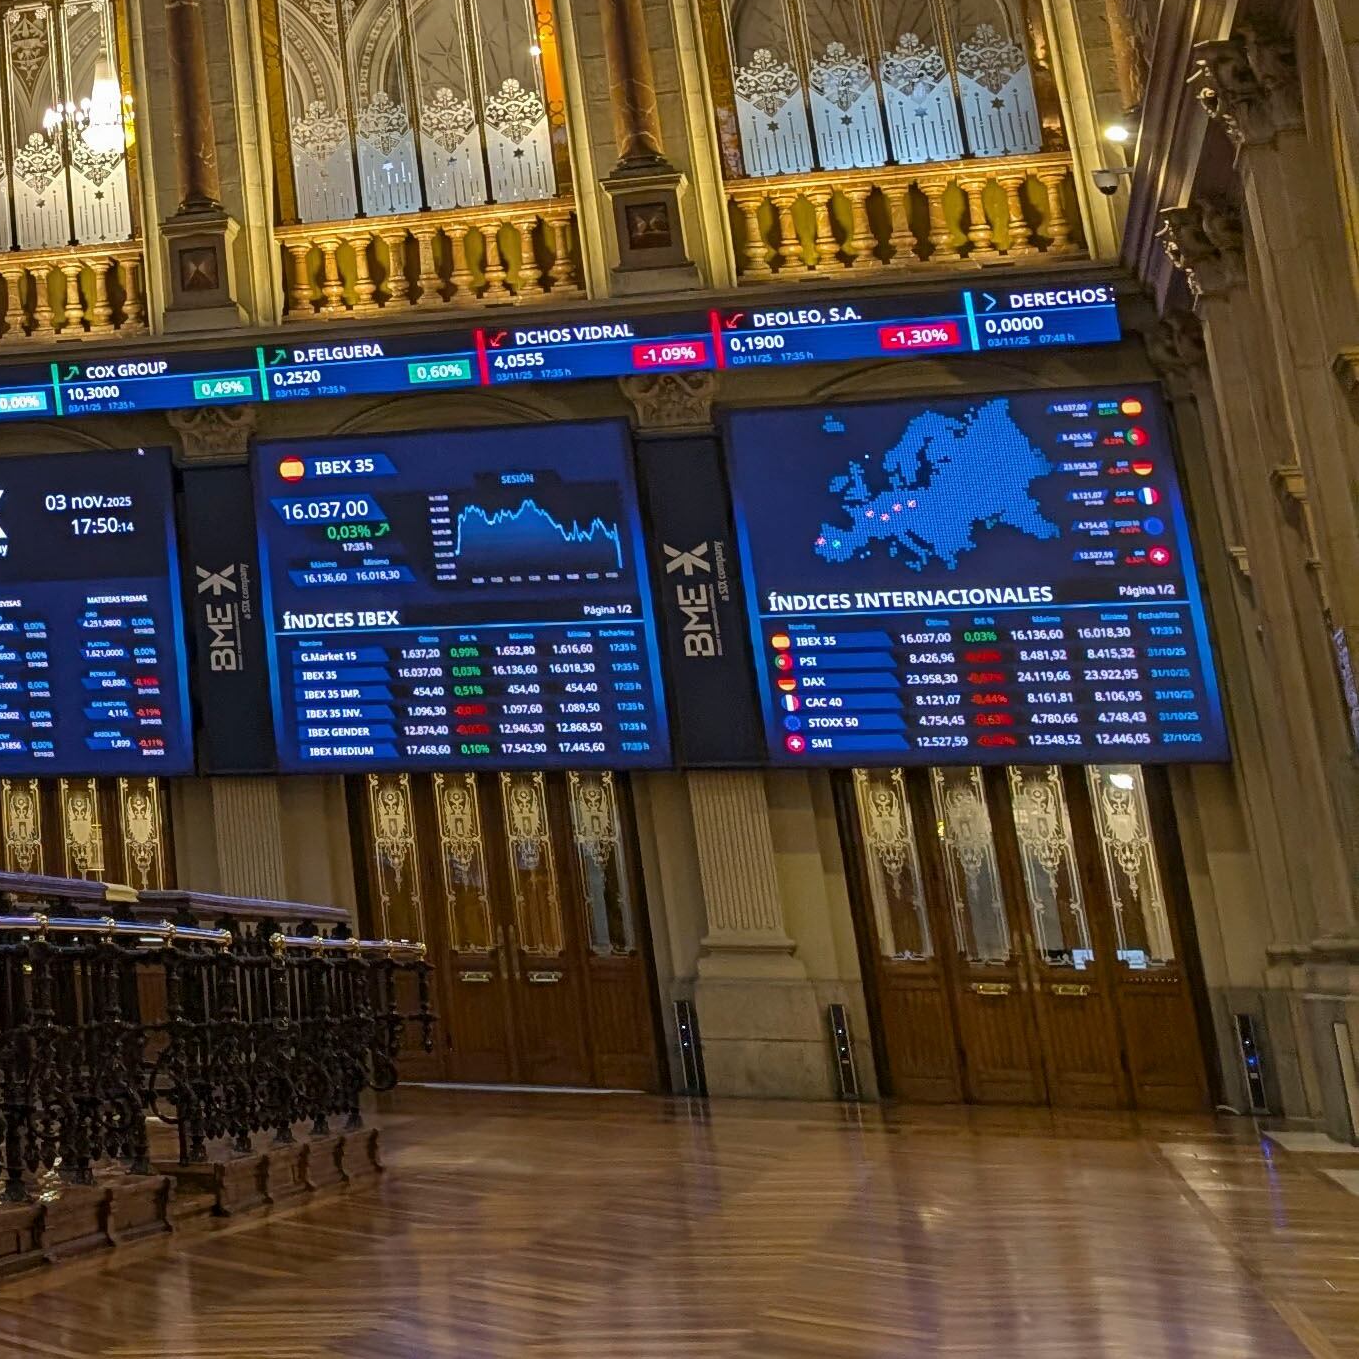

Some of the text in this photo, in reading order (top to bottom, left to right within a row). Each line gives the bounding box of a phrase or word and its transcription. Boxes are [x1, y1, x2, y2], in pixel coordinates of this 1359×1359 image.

[1009, 289, 1106, 309] DERECHOS
[753, 307, 861, 328] DEOLEO, S.A.
[985, 316, 1044, 334] 0,0000
[515, 323, 634, 346] DCHOS VIDRAL
[890, 328, 948, 346] -1,30%
[730, 335, 784, 353] 0,1900
[293, 343, 383, 363] D.FELGUERA
[642, 345, 696, 363] -1,09%
[494, 352, 545, 369] 4,0555
[85, 361, 168, 379] COX GROUP
[417, 362, 463, 380] 0,60%
[273, 369, 321, 386] 0,2520
[68, 385, 120, 401] 10,3000
[201, 380, 244, 397] 0,49%
[315, 458, 374, 475] IBEX 35
[501, 473, 534, 485] SESIÓN
[45, 495, 67, 511] 03
[282, 500, 368, 520] 16.037,00
[327, 524, 371, 540] 0,03%
[304, 573, 347, 583] 16.136,60
[356, 570, 400, 581] 16.018,30
[1119, 584, 1175, 597] Página 1/2
[768, 586, 1053, 611] ÍNDICES INTERNACIONALES
[584, 604, 632, 616] Página 1/2
[283, 610, 399, 630] ÍNDICES IBEX
[677, 584, 715, 657] BME
[206, 603, 237, 671] BME
[901, 633, 951, 644] 16.037,00
[1011, 629, 1064, 641] 16.136,60
[1078, 627, 1131, 639] 16.018,30
[797, 636, 836, 646] IBEX 35
[402, 649, 440, 659] 1.637,20
[495, 646, 535, 656] 1.652,80
[553, 644, 592, 654] 1.616,60
[1087, 648, 1135, 659] 8.415,32
[301, 651, 357, 663] G.Market 15
[909, 653, 954, 664] 8.426,96
[1020, 650, 1067, 661] 8.481,92
[800, 657, 817, 666] PSI
[399, 668, 442, 678] 16.037,00
[493, 665, 537, 675] 16.136,60
[549, 663, 595, 673] 16.018,30
[302, 671, 337, 680] IBEX 35
[907, 674, 958, 685] 23.958,30
[1017, 671, 1071, 683] 24.119,66
[1084, 669, 1139, 681] 23.922,95
[803, 677, 825, 687] DAX
[413, 687, 444, 696] 454,40
[508, 684, 539, 694] 454,40
[565, 683, 597, 693] 454,40
[305, 689, 361, 699] IBEX 35 IMP.
[1028, 693, 1073, 704] 8.161,81
[1095, 691, 1143, 702] 8.106,95
[806, 697, 842, 707] CAC 40
[916, 695, 961, 706] 8.121,07
[408, 706, 446, 716] 1.096,30
[502, 704, 542, 714] 1.097,60
[560, 702, 600, 712] 1.089,50
[306, 709, 362, 718] IBEX 35 INV.
[1031, 713, 1078, 725] 4.780,66
[1098, 712, 1146, 723] 4.748,43
[809, 718, 858, 728] STOXX 50
[919, 715, 965, 726] 4.754,45
[308, 727, 369, 737] IBEX GENDER
[404, 726, 448, 736] 12.874,40
[499, 723, 544, 734] 12.946,30
[556, 722, 602, 732] 12.868,50
[812, 739, 832, 748] SMI
[917, 736, 968, 747] 12.527,59
[1029, 735, 1081, 747] 12.548,52
[1096, 734, 1151, 745] 12.446,05
[310, 746, 374, 756] IBEX MEDIUM
[407, 746, 450, 756] 17.468,60
[502, 743, 546, 753] 17.542,90
[559, 742, 604, 752] 17.445,60
